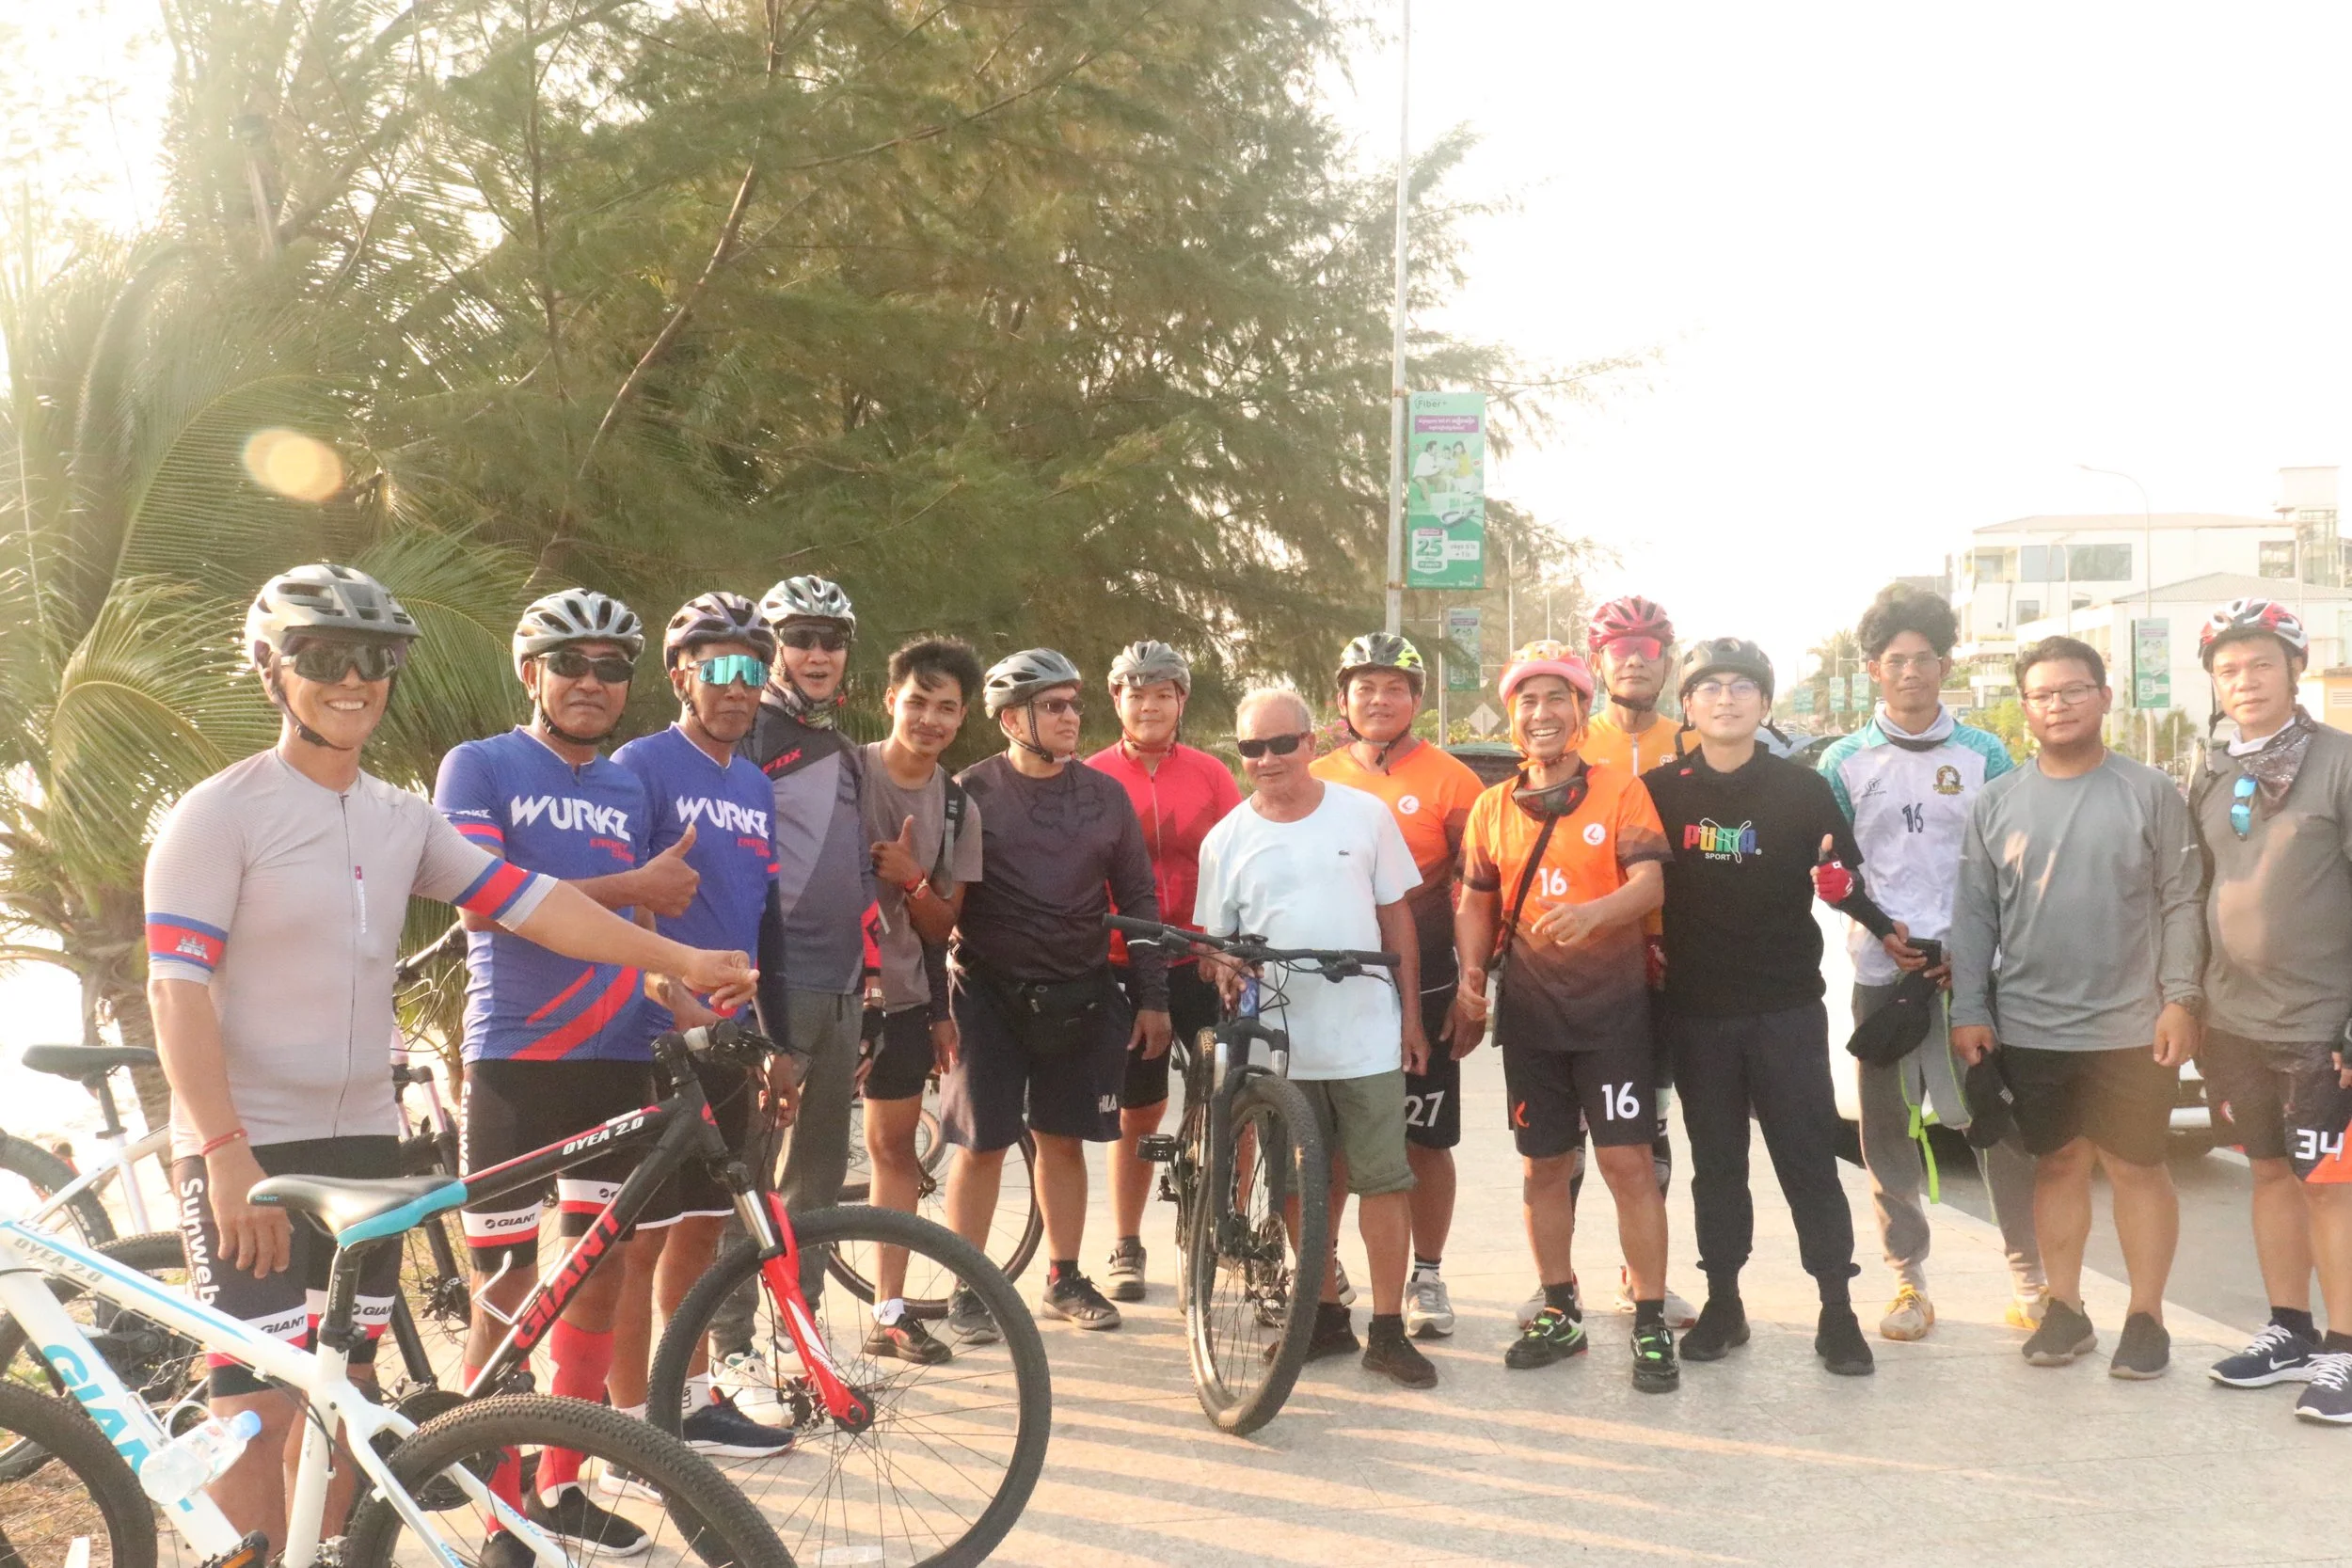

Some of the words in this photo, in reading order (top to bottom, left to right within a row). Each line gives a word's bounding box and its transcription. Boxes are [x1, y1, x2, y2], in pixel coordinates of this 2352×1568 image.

[1416, 538, 1443, 557] 25
[763, 748, 803, 775] FOX
[510, 795, 631, 843] WURKZ
[675, 796, 770, 841] WURKZ
[1902, 801, 1924, 834] 16
[1683, 824, 1756, 854] PUMA
[1705, 852, 1731, 861] SPORT
[1538, 866, 1568, 896] 16
[1404, 1090, 1445, 1127] 27
[1601, 1082, 1640, 1121] 16
[459, 1080, 471, 1177] Sunwe
[614, 1117, 644, 1136] 2.0
[2295, 1128, 2344, 1162] 34
[497, 1213, 535, 1227] GIANT
[181, 1178, 220, 1305] Sunweb
[330, 1281, 340, 1310] GIANT
[514, 1212, 619, 1349] GIANT
[362, 1305, 393, 1316] GIAN
